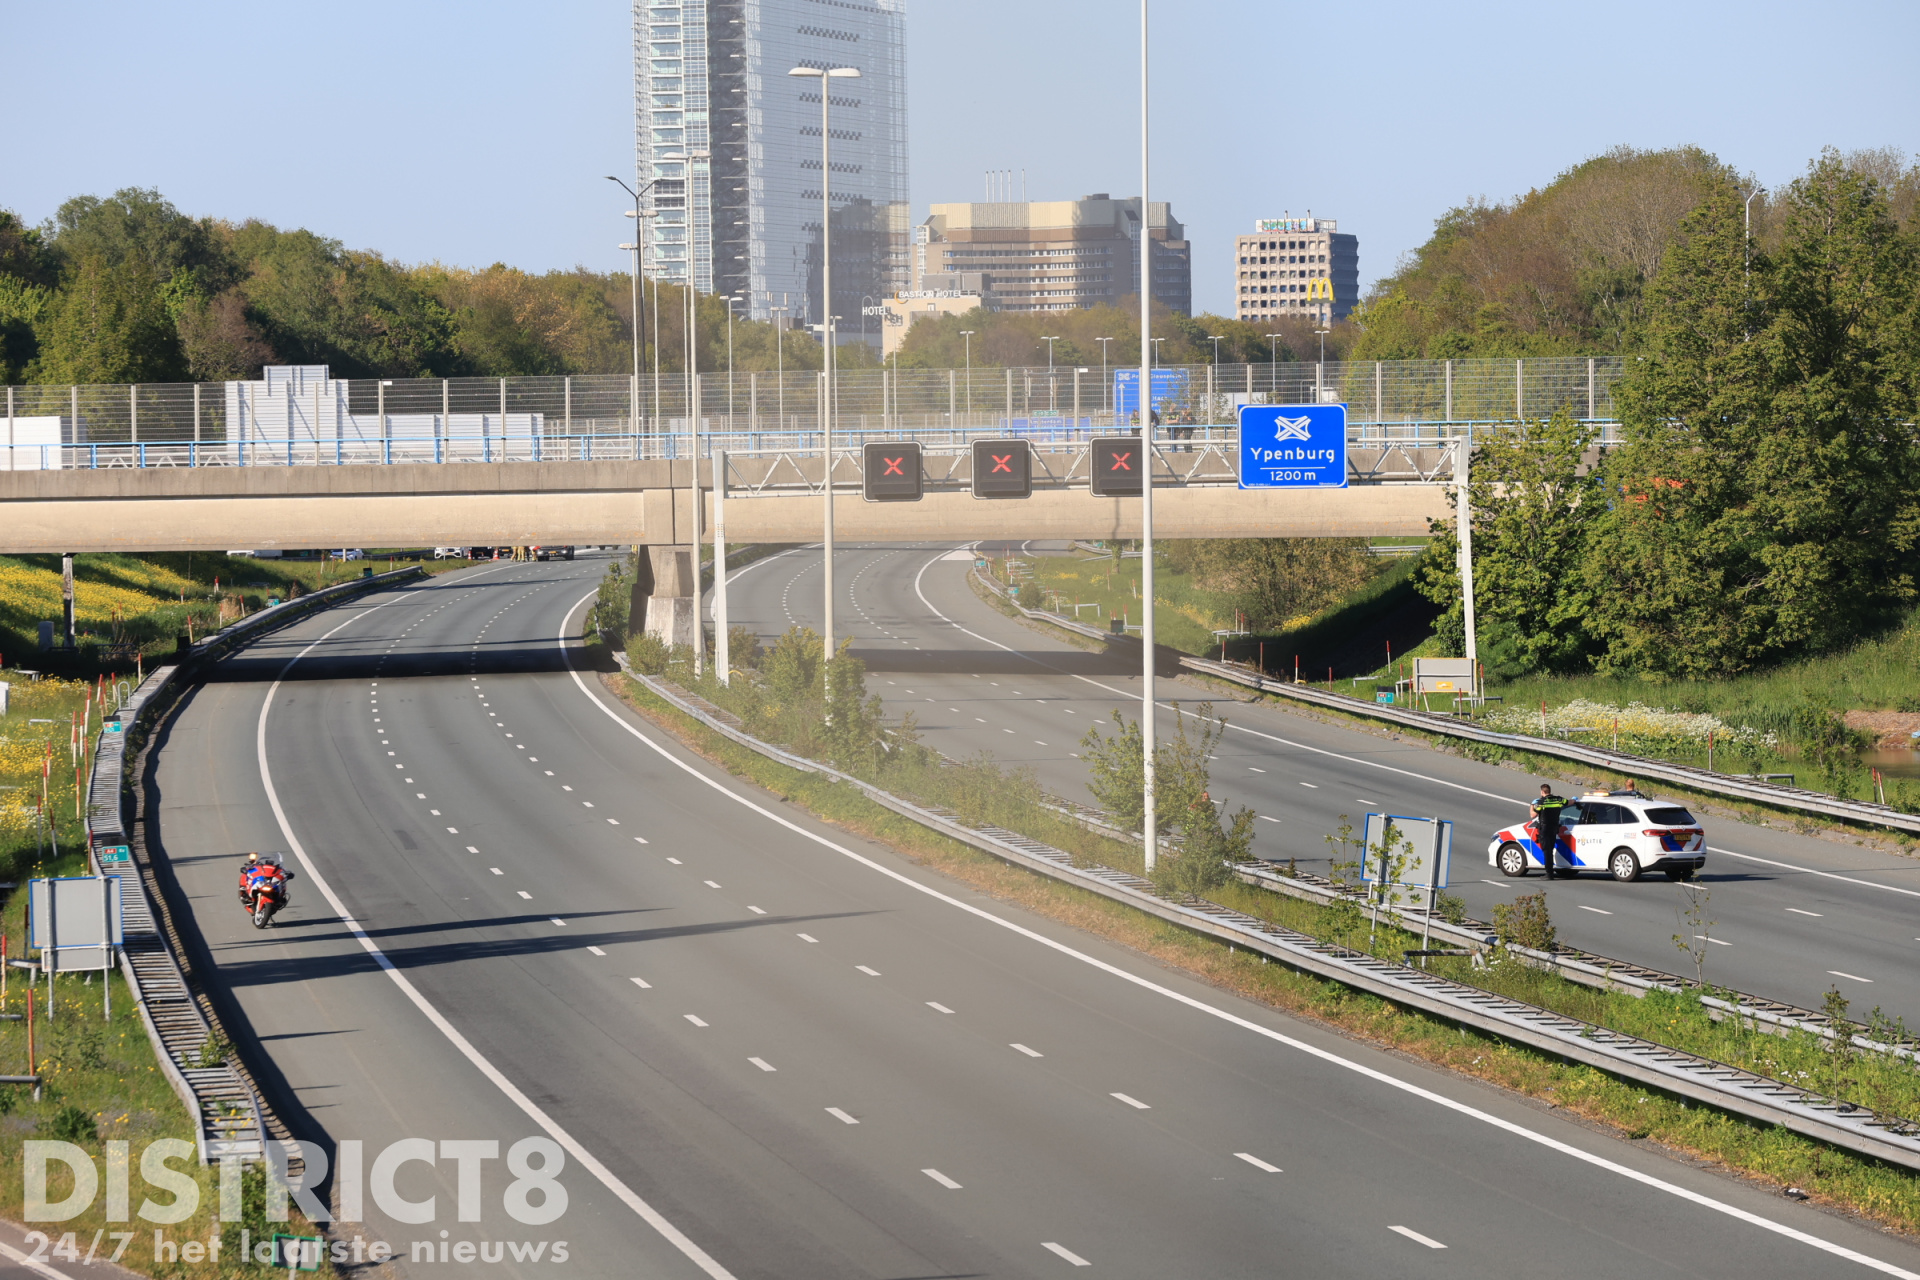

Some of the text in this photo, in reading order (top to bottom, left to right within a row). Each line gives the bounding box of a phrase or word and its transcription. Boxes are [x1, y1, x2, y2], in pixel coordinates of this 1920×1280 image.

[862, 306, 888, 316] HOTEL
[1250, 447, 1335, 463] Ypenburg
[1270, 471, 1316, 481] 1200 m
[1577, 837, 1602, 845] POLITIE
[103, 854, 119, 862] 51,6
